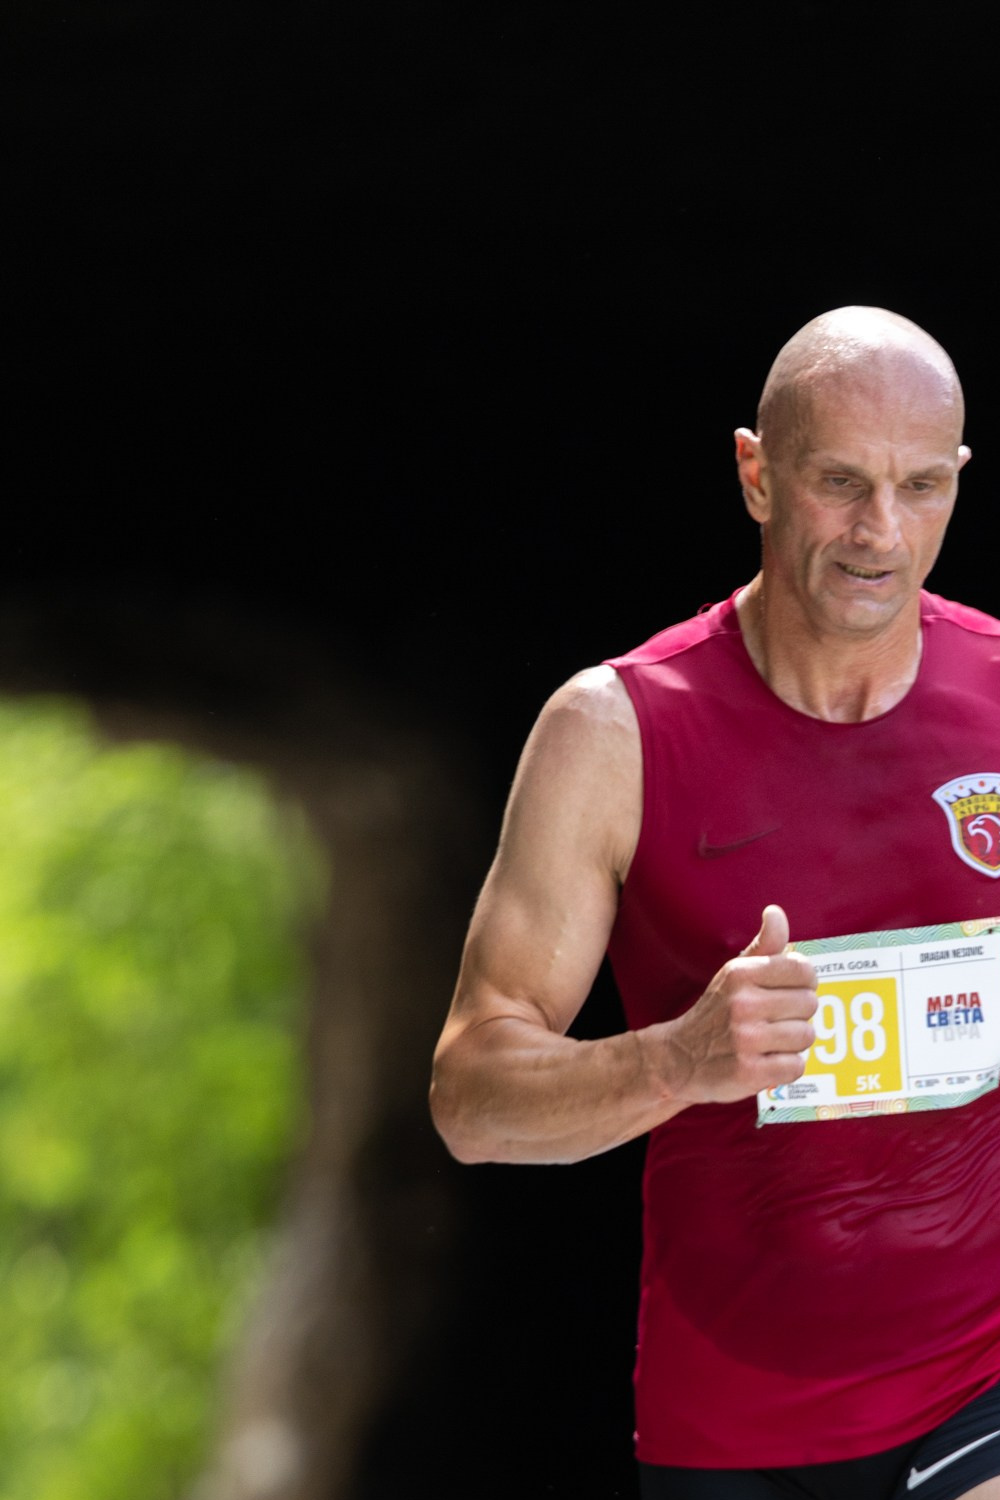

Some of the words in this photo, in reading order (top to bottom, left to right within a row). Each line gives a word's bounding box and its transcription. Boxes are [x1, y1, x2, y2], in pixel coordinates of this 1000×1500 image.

[847, 960, 878, 970] GORA
[800, 991, 887, 1065] 98
[856, 1074, 882, 1092] 5K
